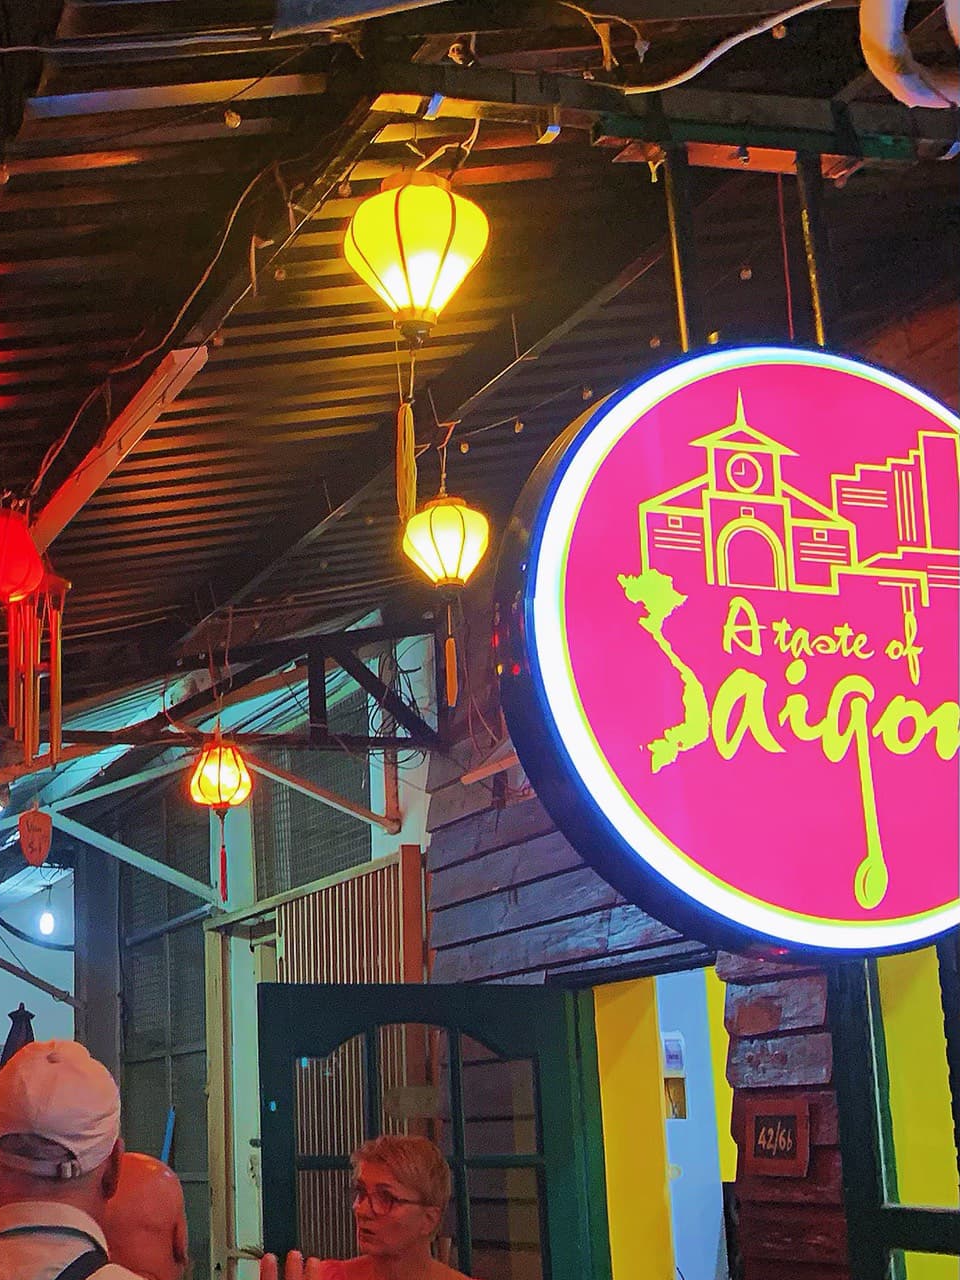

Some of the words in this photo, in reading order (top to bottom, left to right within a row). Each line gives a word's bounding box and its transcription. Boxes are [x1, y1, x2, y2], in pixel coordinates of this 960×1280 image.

[722, 595, 767, 656] A
[772, 618, 875, 660] taste
[885, 611, 924, 686] of
